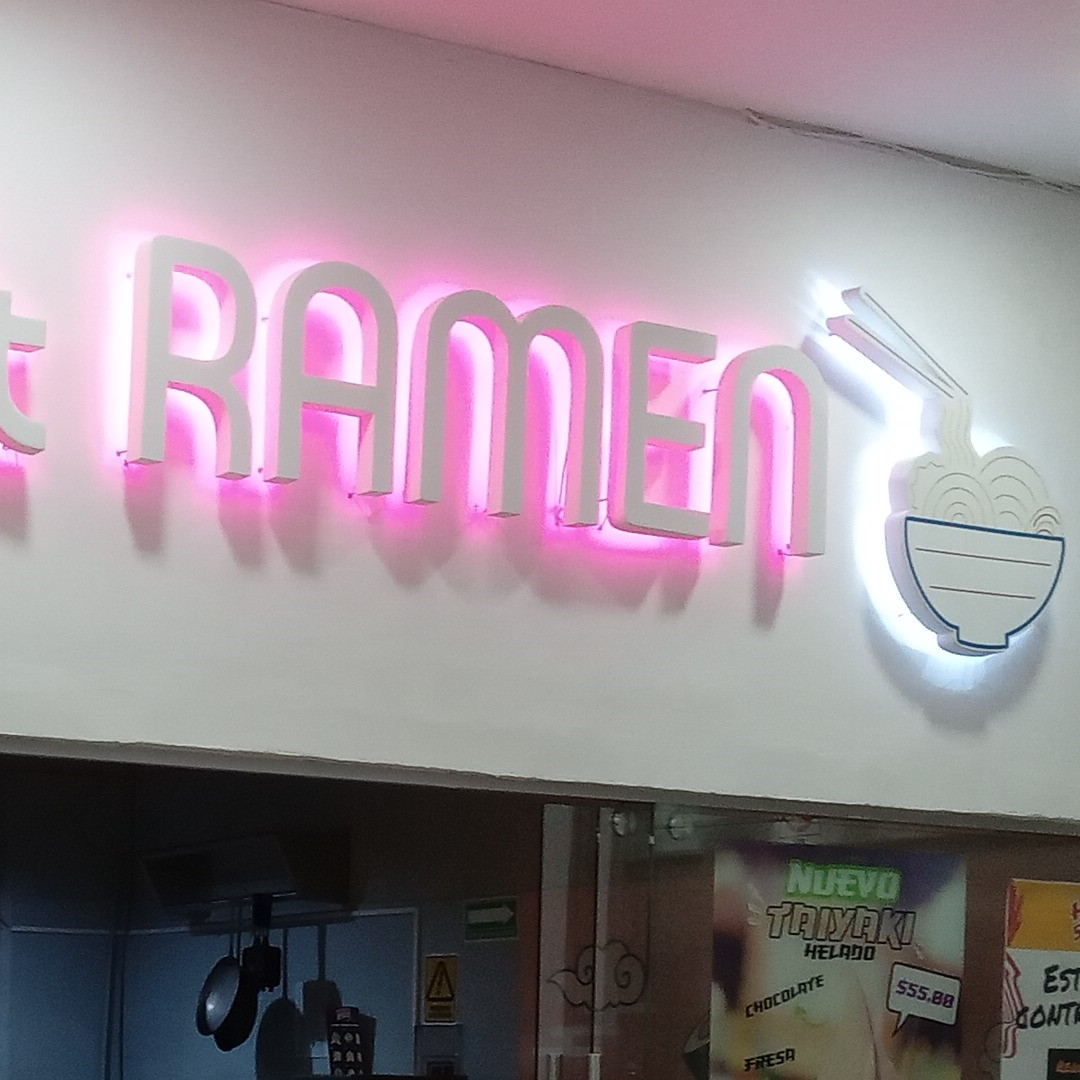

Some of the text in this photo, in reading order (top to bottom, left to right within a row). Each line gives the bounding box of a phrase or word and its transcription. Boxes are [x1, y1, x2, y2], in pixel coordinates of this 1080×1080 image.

[127, 234, 828, 557] RAMEN
[786, 859, 902, 901] NUEVO
[766, 901, 916, 950] TAIYAKI
[804, 943, 876, 961] HELADO
[745, 975, 825, 1018] CHOCOLATE
[744, 1048, 796, 1071] FRESA
